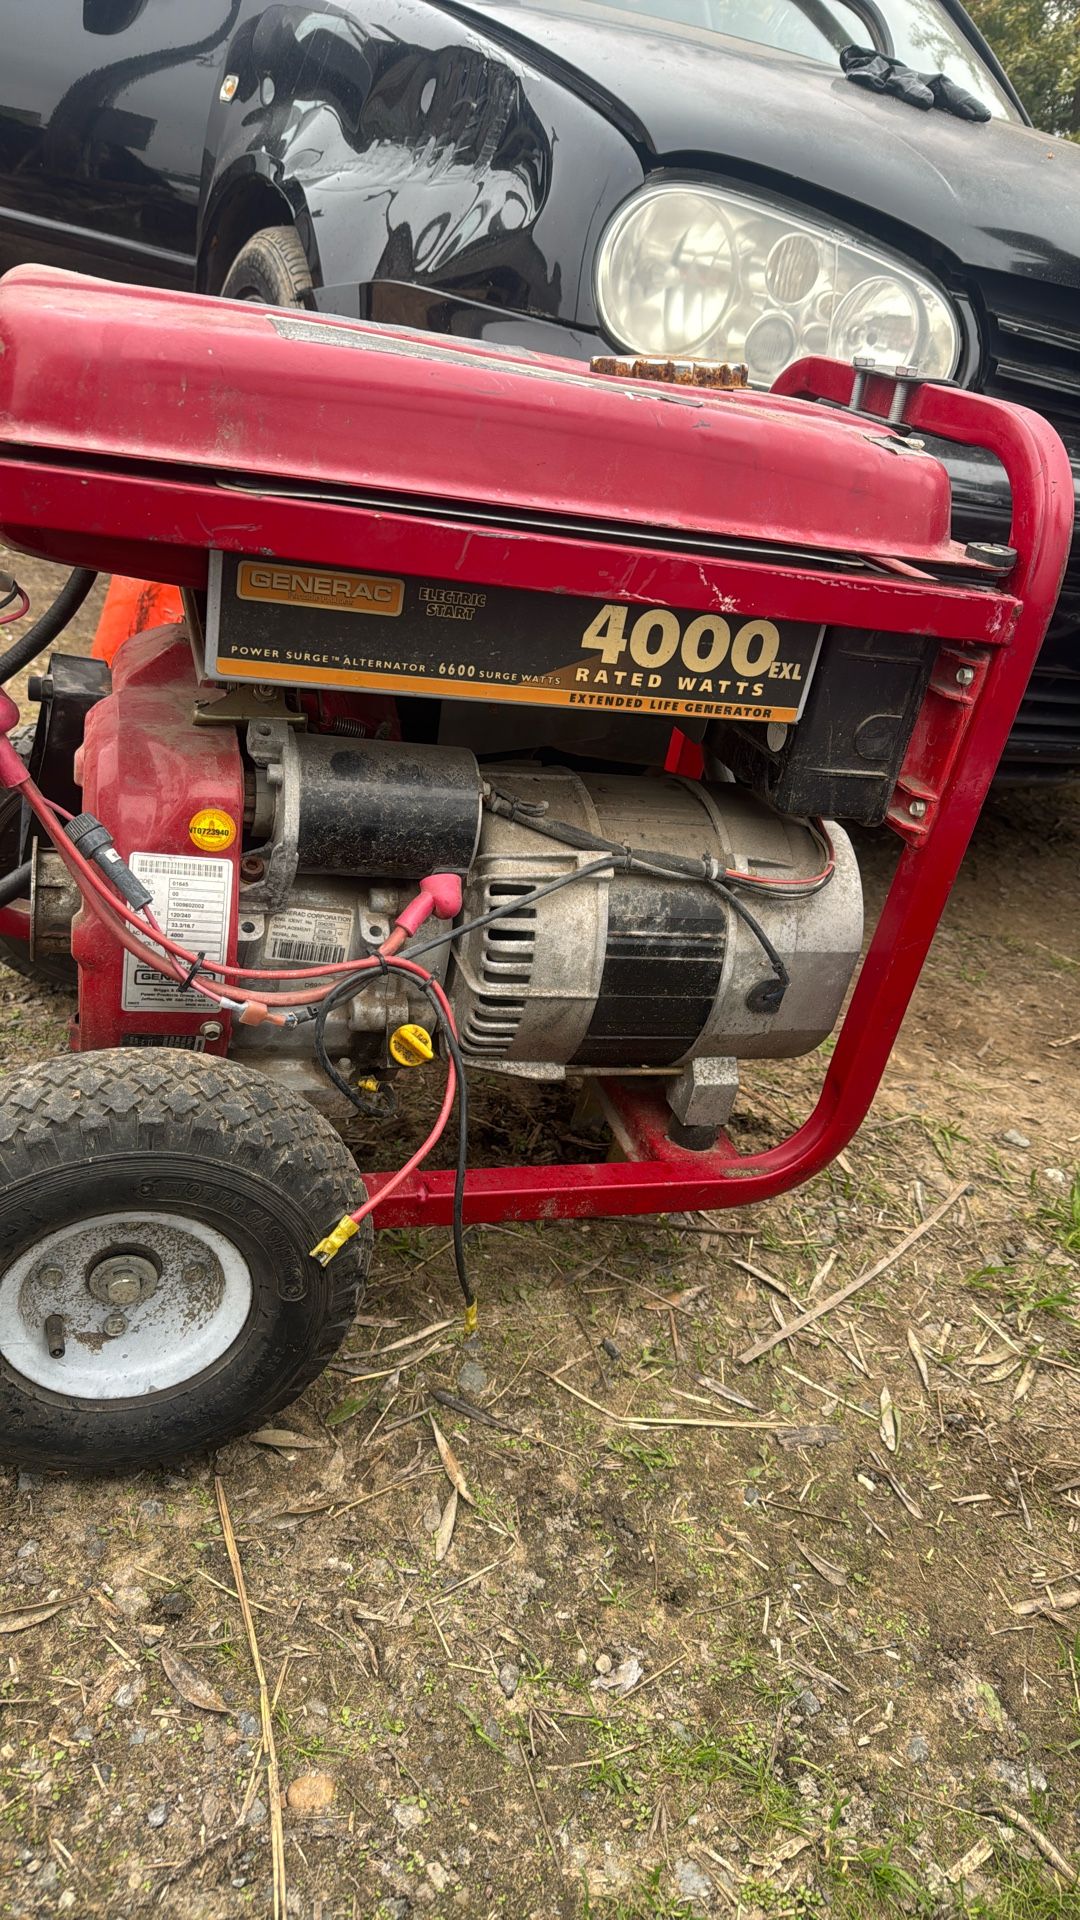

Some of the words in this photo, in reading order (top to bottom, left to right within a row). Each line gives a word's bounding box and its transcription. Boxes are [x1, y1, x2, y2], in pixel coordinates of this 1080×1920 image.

[250, 569, 393, 602] GENERAC
[419, 587, 487, 607] ELECTRIC
[426, 603, 475, 620] START
[580, 604, 780, 677] 4000
[767, 661, 802, 681] EXL
[231, 645, 279, 658] POWER
[343, 656, 426, 672] ALTERNATOR
[438, 662, 475, 677] 6600
[479, 670, 518, 681] SURGE
[521, 674, 561, 685] WATTS
[575, 667, 662, 688] RATED
[678, 676, 765, 697] WATTS
[569, 693, 642, 708] EXTENDED
[649, 700, 679, 711] LIFE
[684, 702, 773, 718] GENERATOR
[307, 912, 352, 923] CORPORATION
